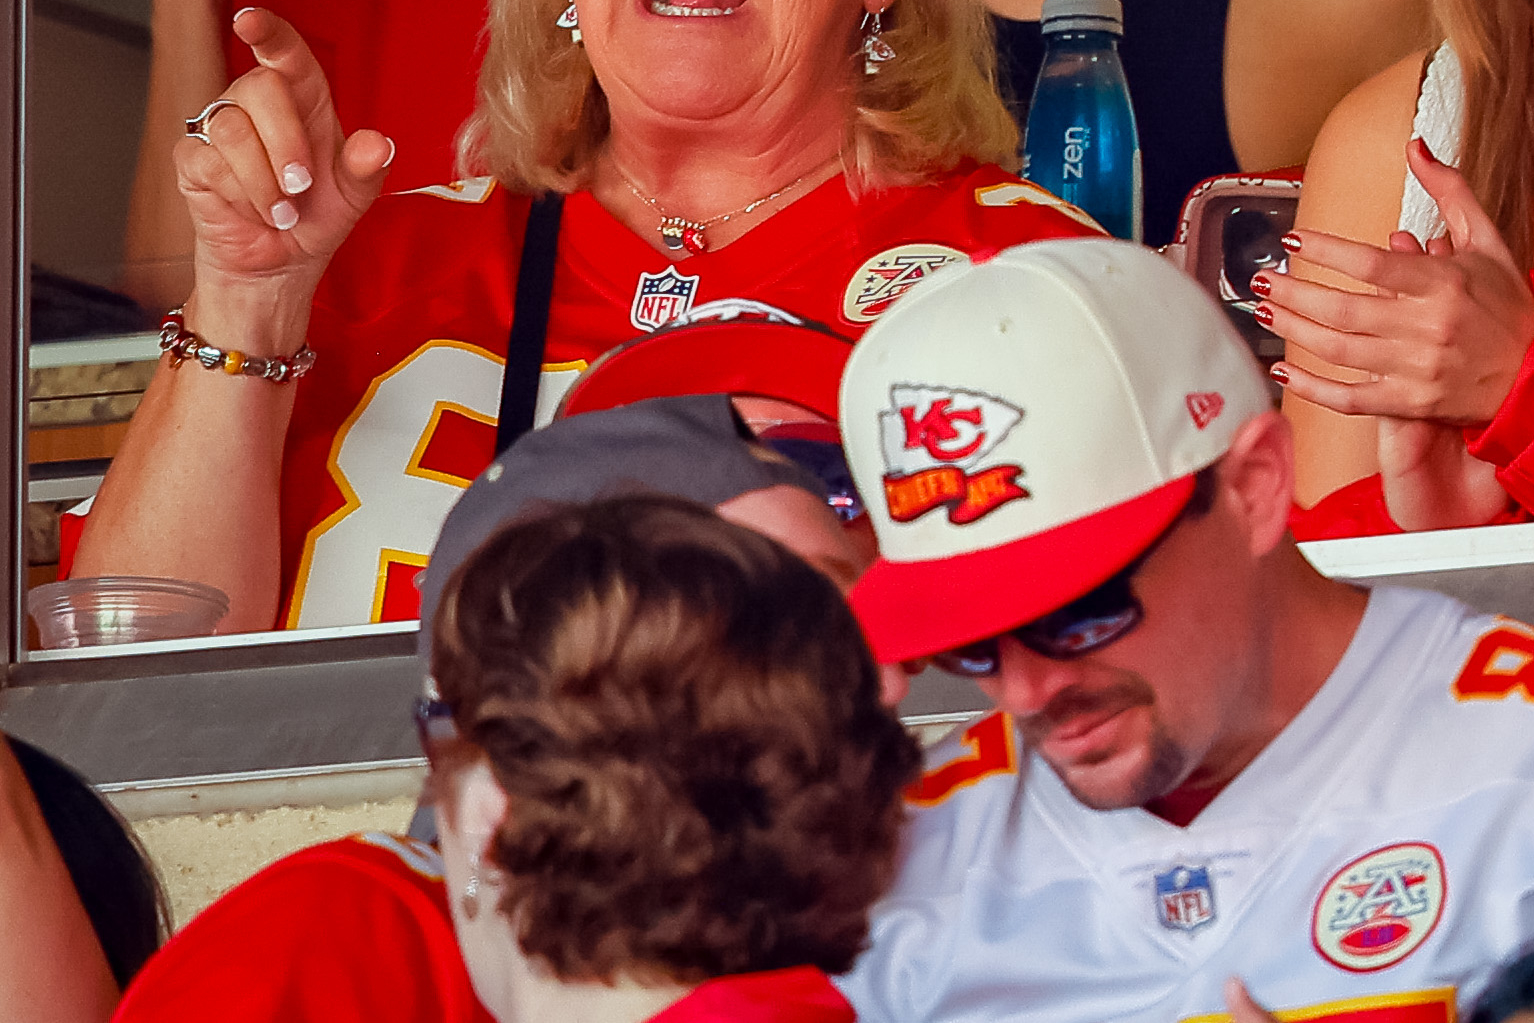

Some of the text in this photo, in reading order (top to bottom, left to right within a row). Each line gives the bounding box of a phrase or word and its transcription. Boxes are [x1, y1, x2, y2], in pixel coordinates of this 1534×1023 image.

[1063, 126, 1083, 179] zen
[639, 295, 681, 325] NFL
[1163, 890, 1211, 923] NFL
